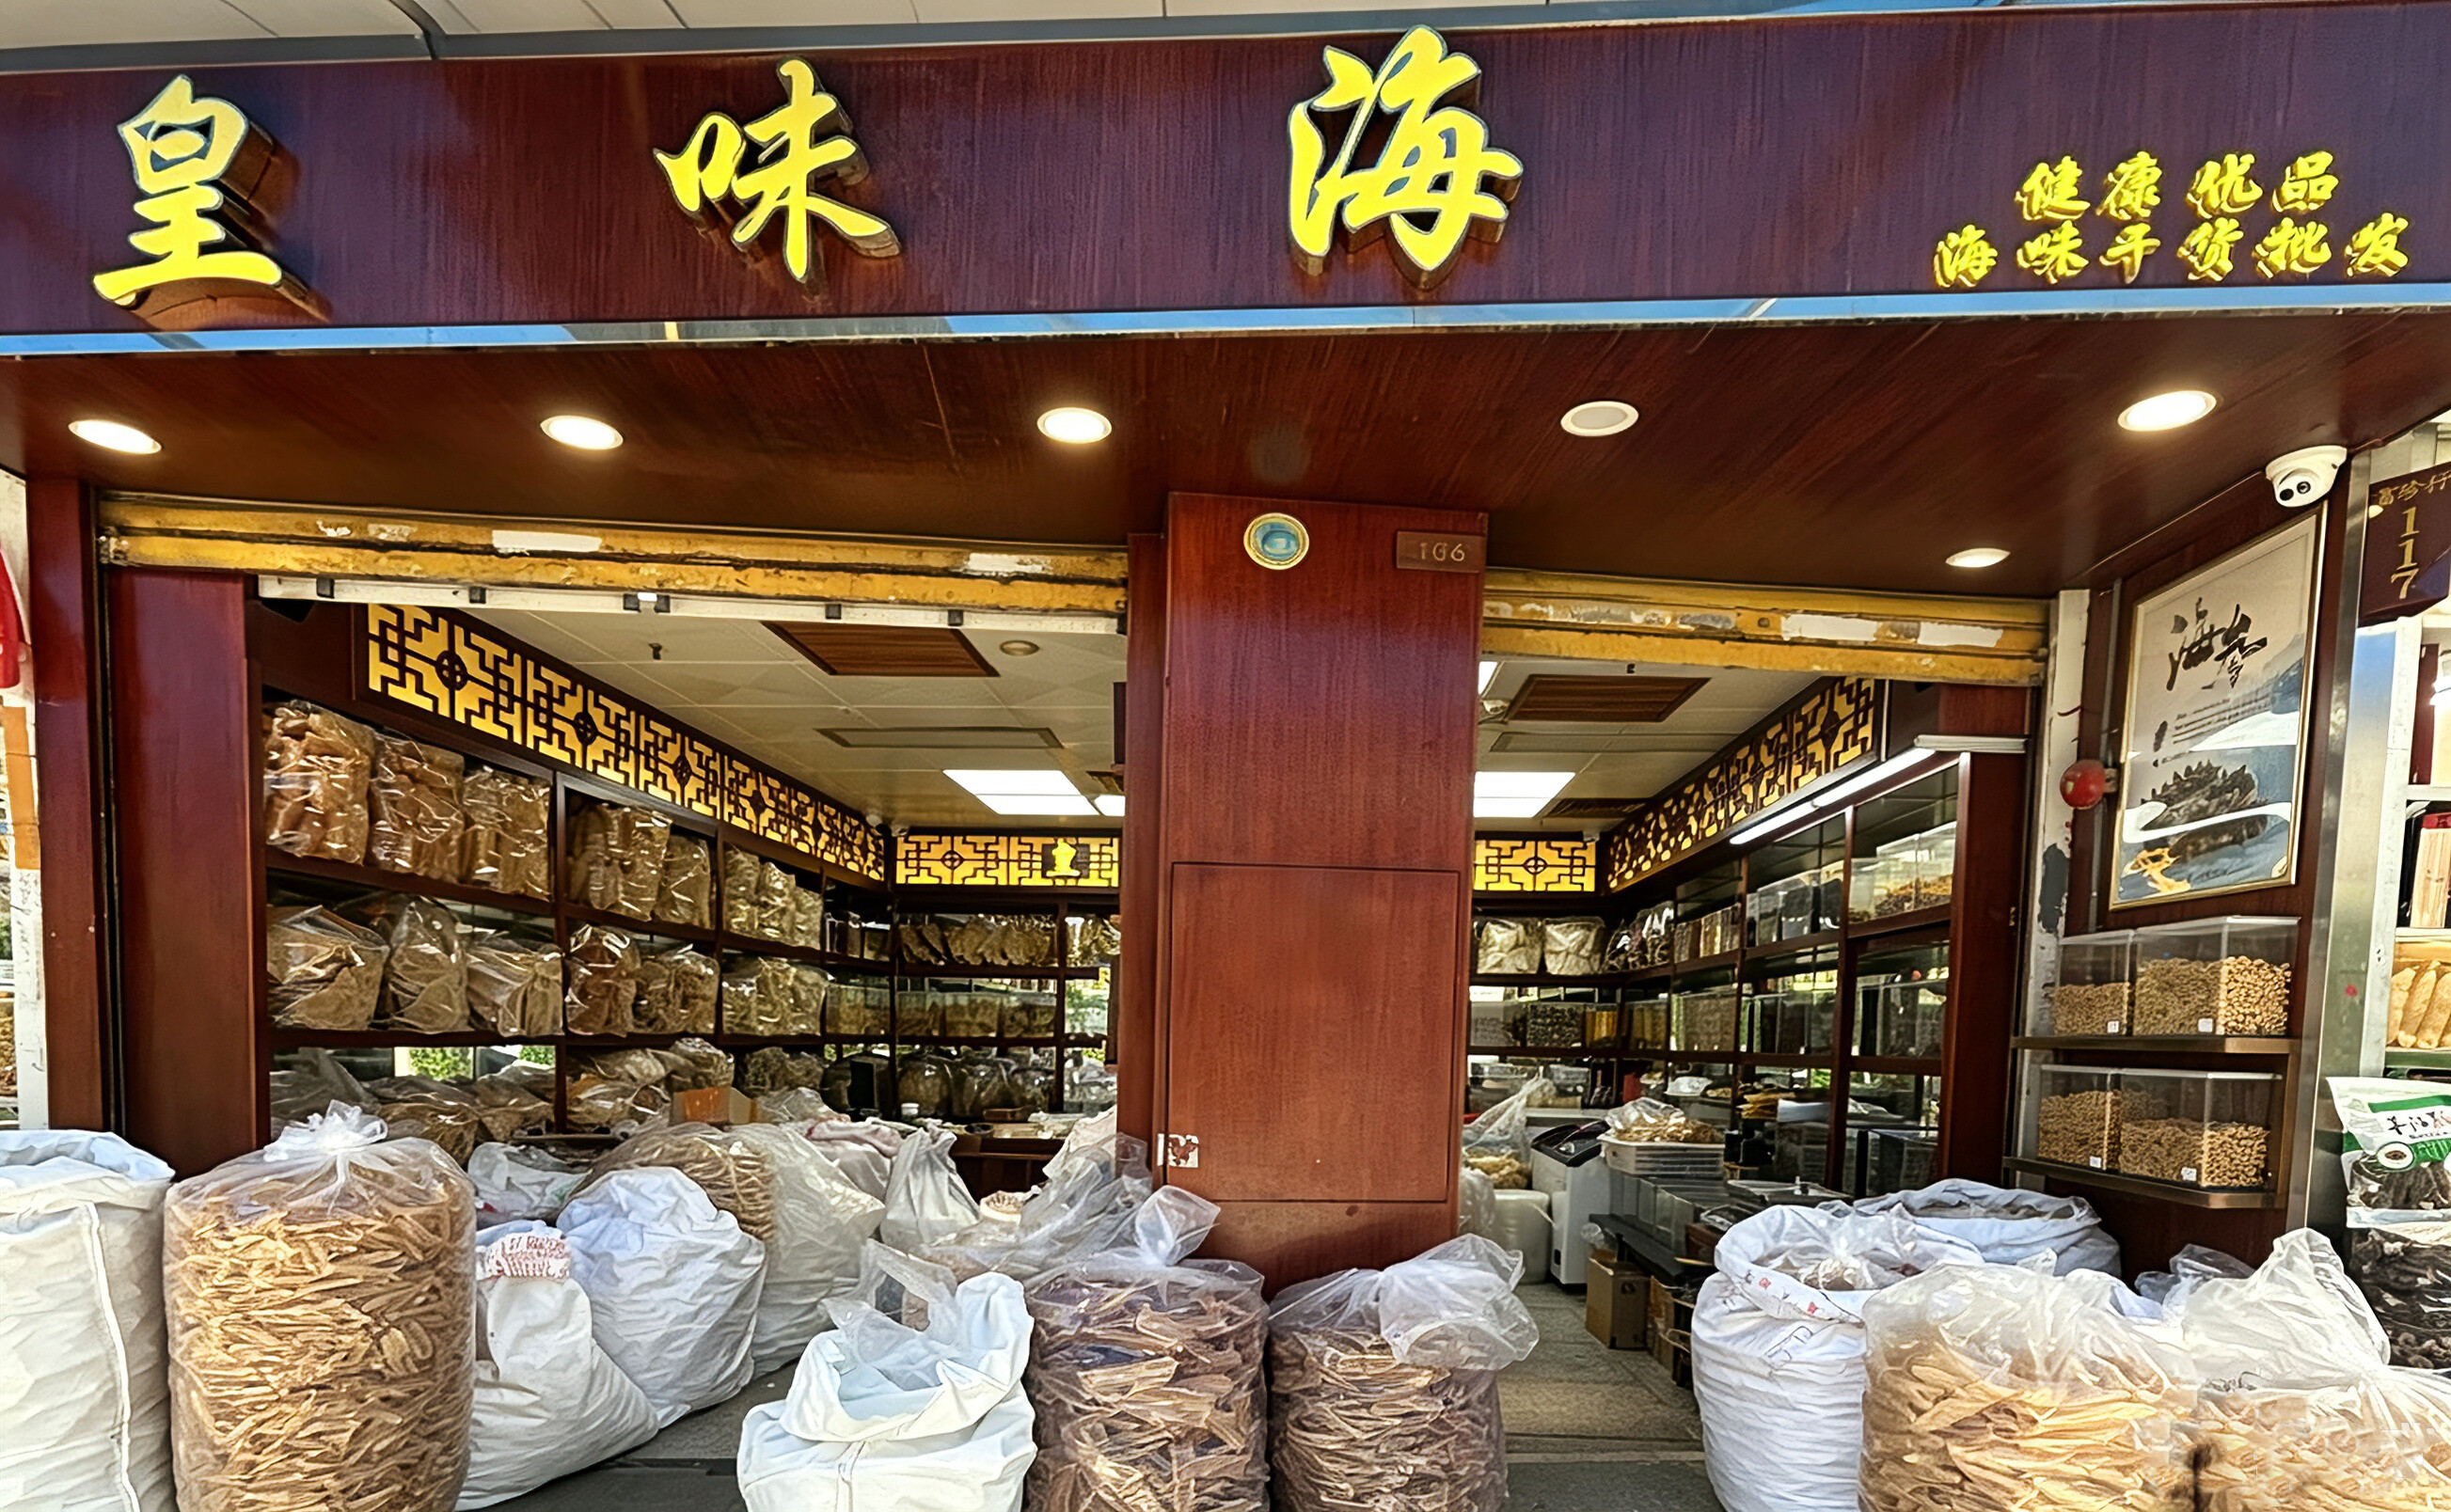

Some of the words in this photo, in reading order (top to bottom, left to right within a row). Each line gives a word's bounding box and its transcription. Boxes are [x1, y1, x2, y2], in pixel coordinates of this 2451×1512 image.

[2016, 150, 2340, 222] 健康优品
[1935, 213, 2411, 287] 海味干货批发
[1419, 542, 1465, 562] 106
[2391, 506, 2420, 599] 117
